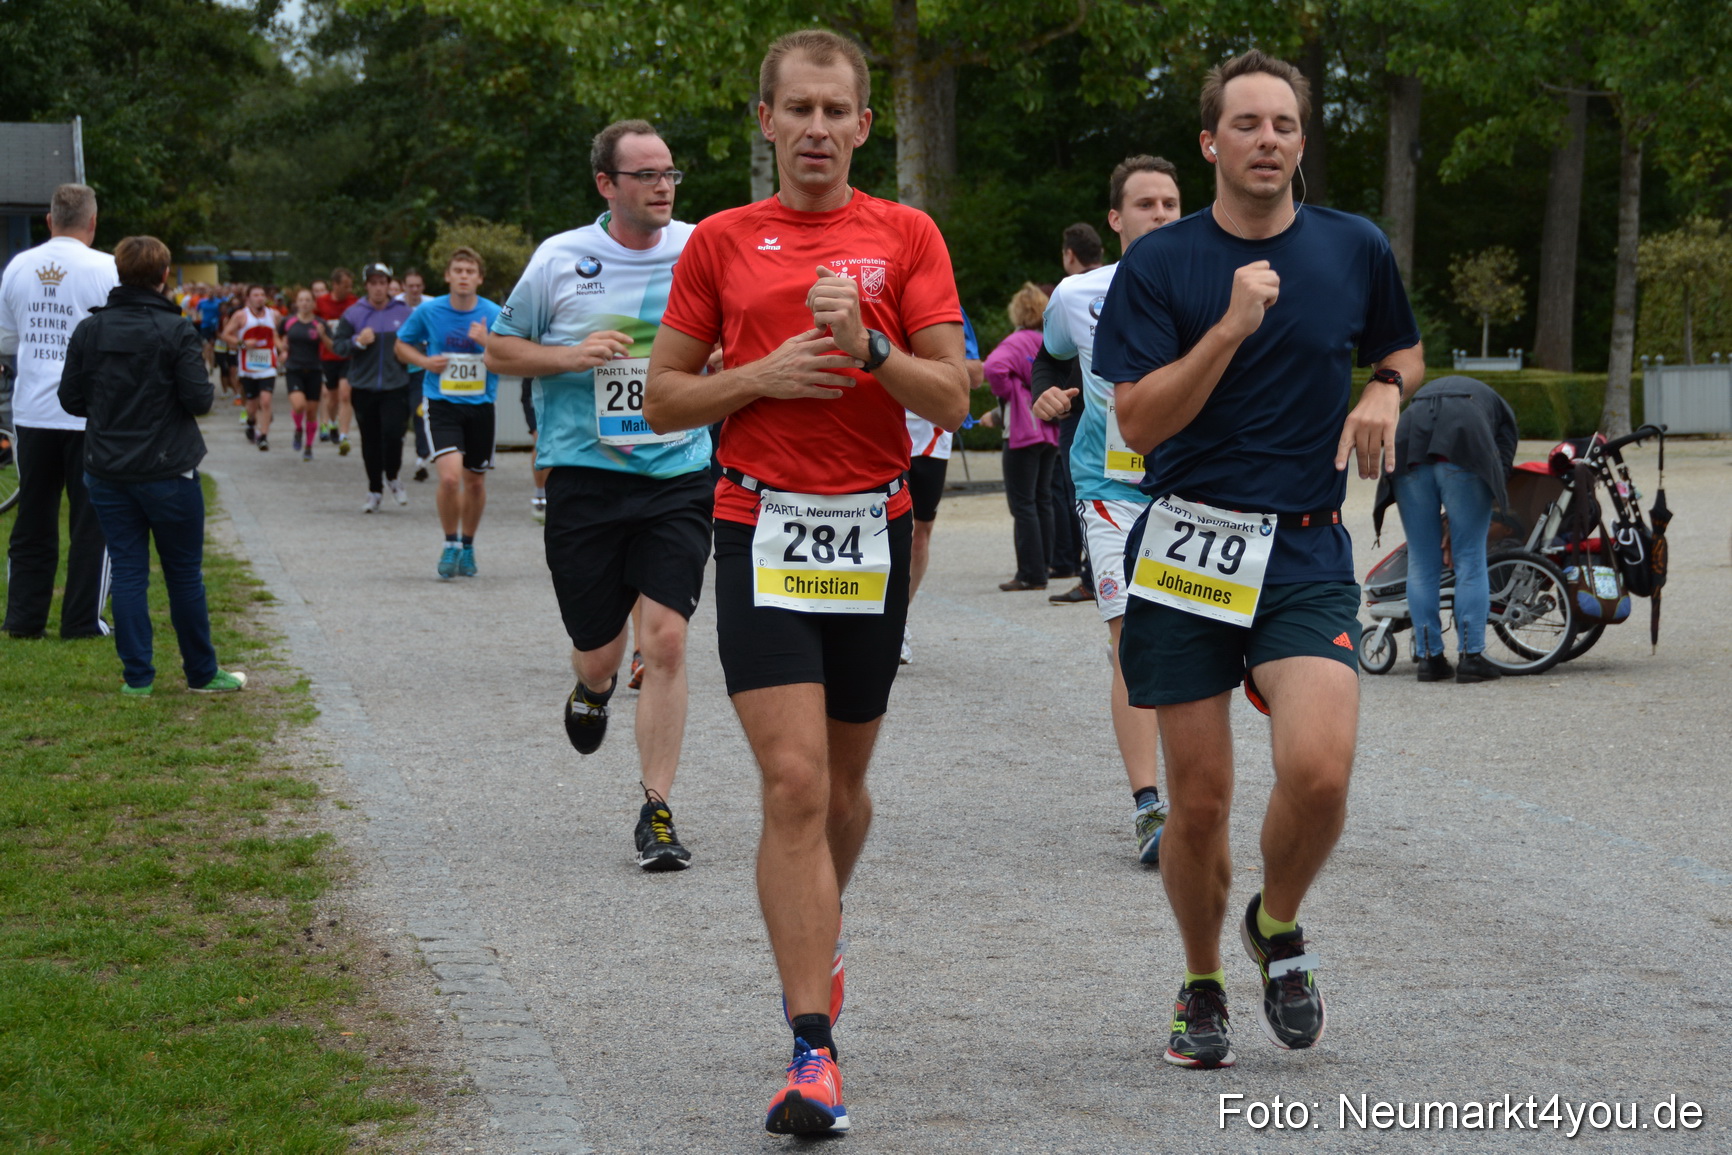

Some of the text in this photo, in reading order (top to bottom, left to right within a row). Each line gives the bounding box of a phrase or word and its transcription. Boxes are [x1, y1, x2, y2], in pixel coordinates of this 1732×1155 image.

[849, 258, 886, 266] Wolfstein
[44, 287, 56, 298] IM
[576, 282, 605, 290] PARTL
[30, 317, 67, 331] SEINER
[33, 348, 65, 362] JESUS
[450, 364, 477, 379] 204
[597, 367, 648, 376] PARTL Neu
[606, 380, 644, 411] 28
[764, 503, 866, 518] PARTL Neumarkt
[1196, 515, 1255, 533] Neumarkt
[783, 522, 864, 565] 284
[1165, 520, 1247, 576] 219
[759, 558, 765, 566] C
[784, 575, 859, 595] Christian
[1157, 570, 1233, 605] Johannes
